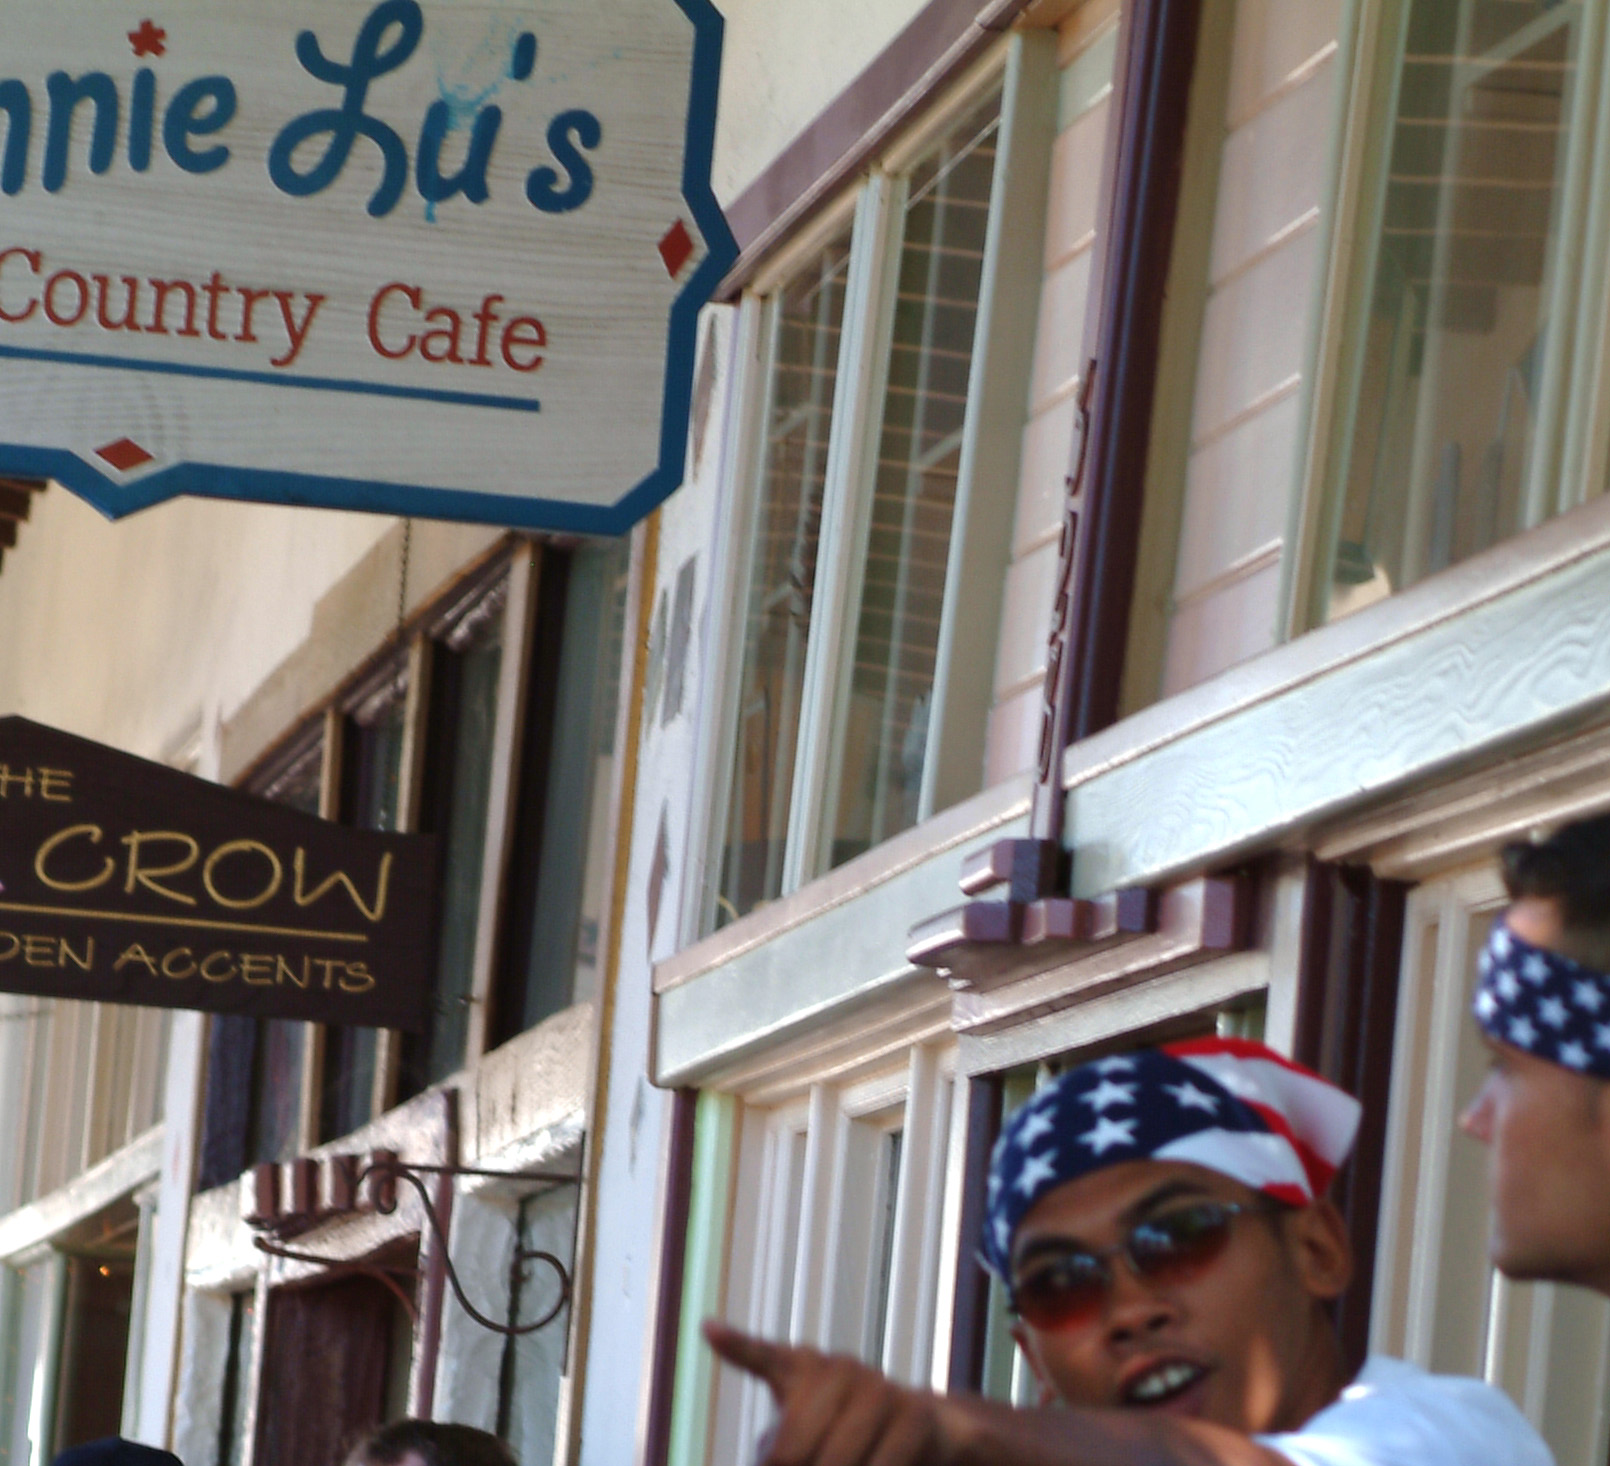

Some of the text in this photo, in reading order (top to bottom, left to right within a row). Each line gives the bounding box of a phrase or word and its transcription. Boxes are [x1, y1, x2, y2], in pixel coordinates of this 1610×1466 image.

[268, 0, 601, 218] Lu's
[0, 247, 547, 373] Country Cafe
[34, 824, 392, 921] CROW
[113, 942, 376, 993] ACCENTS
